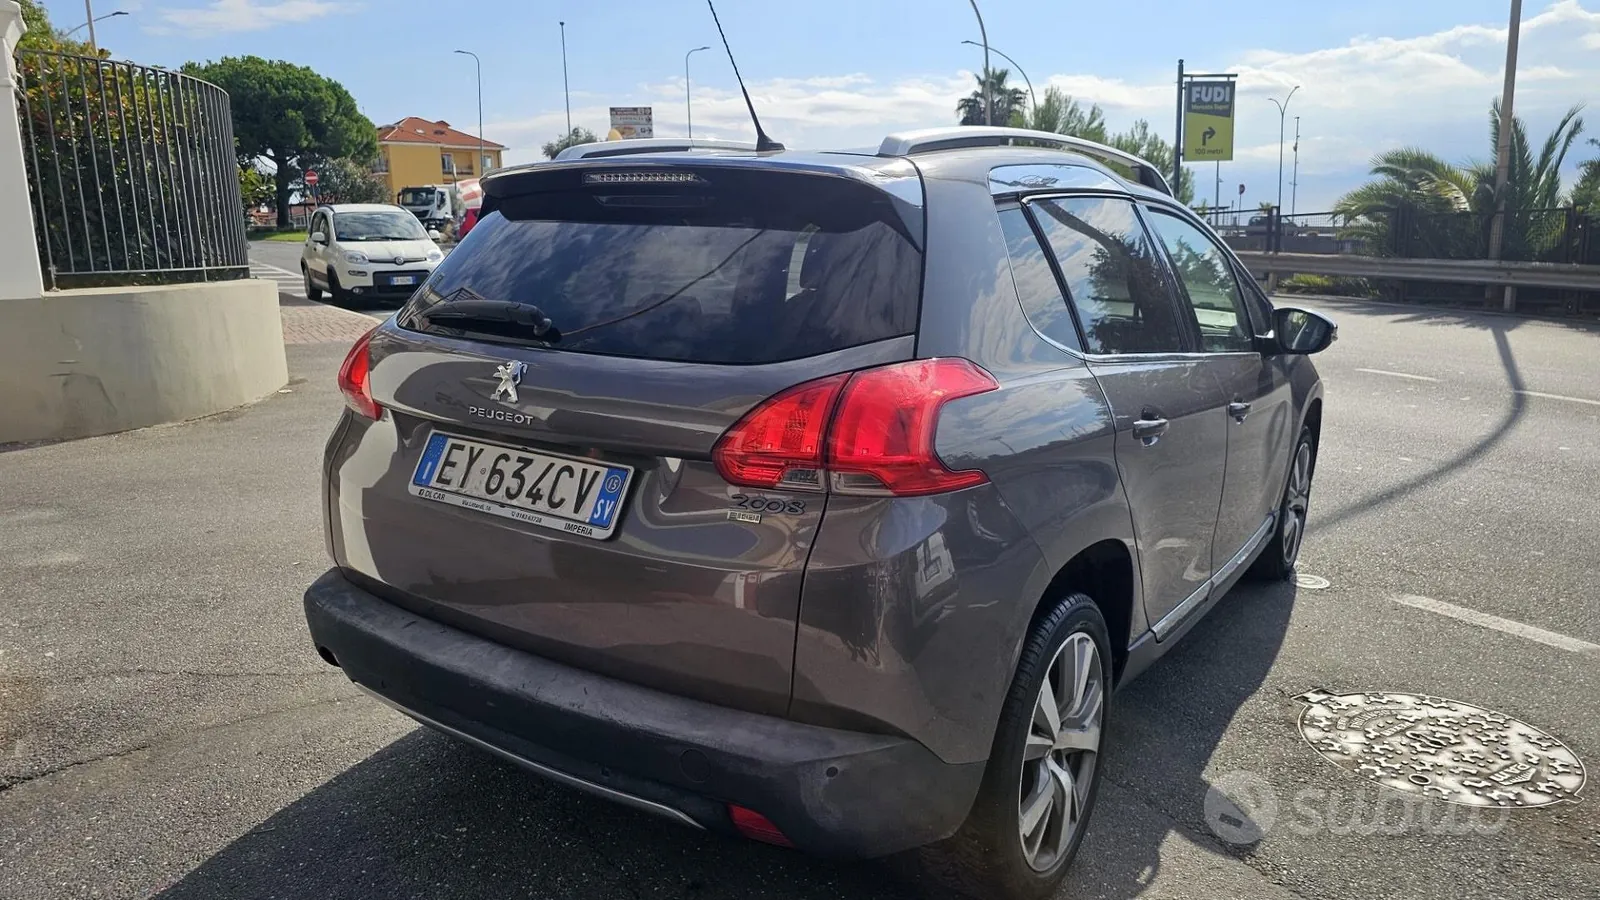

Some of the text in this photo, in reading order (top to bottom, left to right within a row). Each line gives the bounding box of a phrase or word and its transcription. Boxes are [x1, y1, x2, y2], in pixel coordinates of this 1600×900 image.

[1191, 86, 1231, 103] FUDI
[1194, 147, 1223, 156] 100 metri
[468, 406, 534, 425] PEUGEOT
[436, 442, 601, 515] EY 634CV
[607, 478, 618, 491] 15
[593, 499, 615, 521] SV
[731, 494, 806, 516] 2008
[564, 522, 593, 537] IMPERIA
